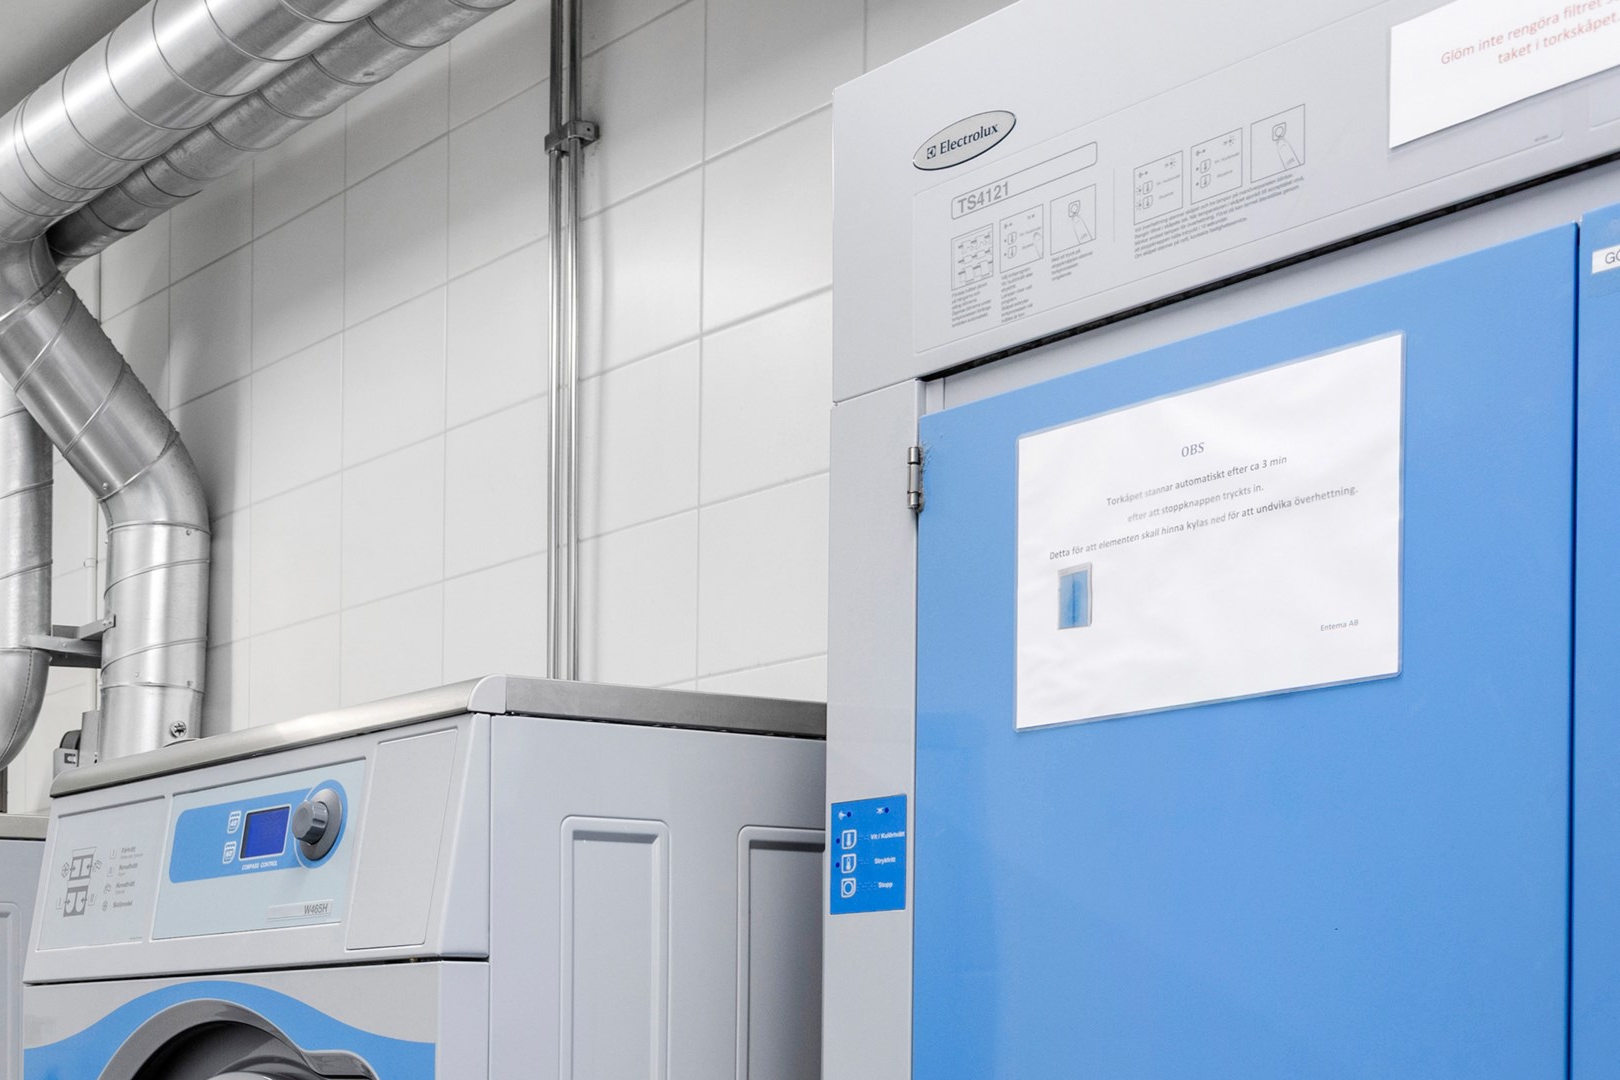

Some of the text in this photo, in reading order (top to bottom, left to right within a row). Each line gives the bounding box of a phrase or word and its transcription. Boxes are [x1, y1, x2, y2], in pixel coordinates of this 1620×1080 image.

[1441, 0, 1602, 65] Glöm inte rengöra filtret
[1498, 12, 1620, 64] taket i torkskåpet.
[940, 124, 998, 154] Electrolux
[957, 181, 1008, 213] TS4121
[1181, 441, 1205, 458] OBS
[1106, 455, 1287, 507] Torkåpet stannar automatiskt efter ca 3 min
[1049, 485, 1359, 560] Detta för att elementen skall hinna kylas ned för att undvika överhettning.
[1127, 483, 1264, 523] efter att stoppknappen tryckts in.
[304, 903, 329, 915] W465H
